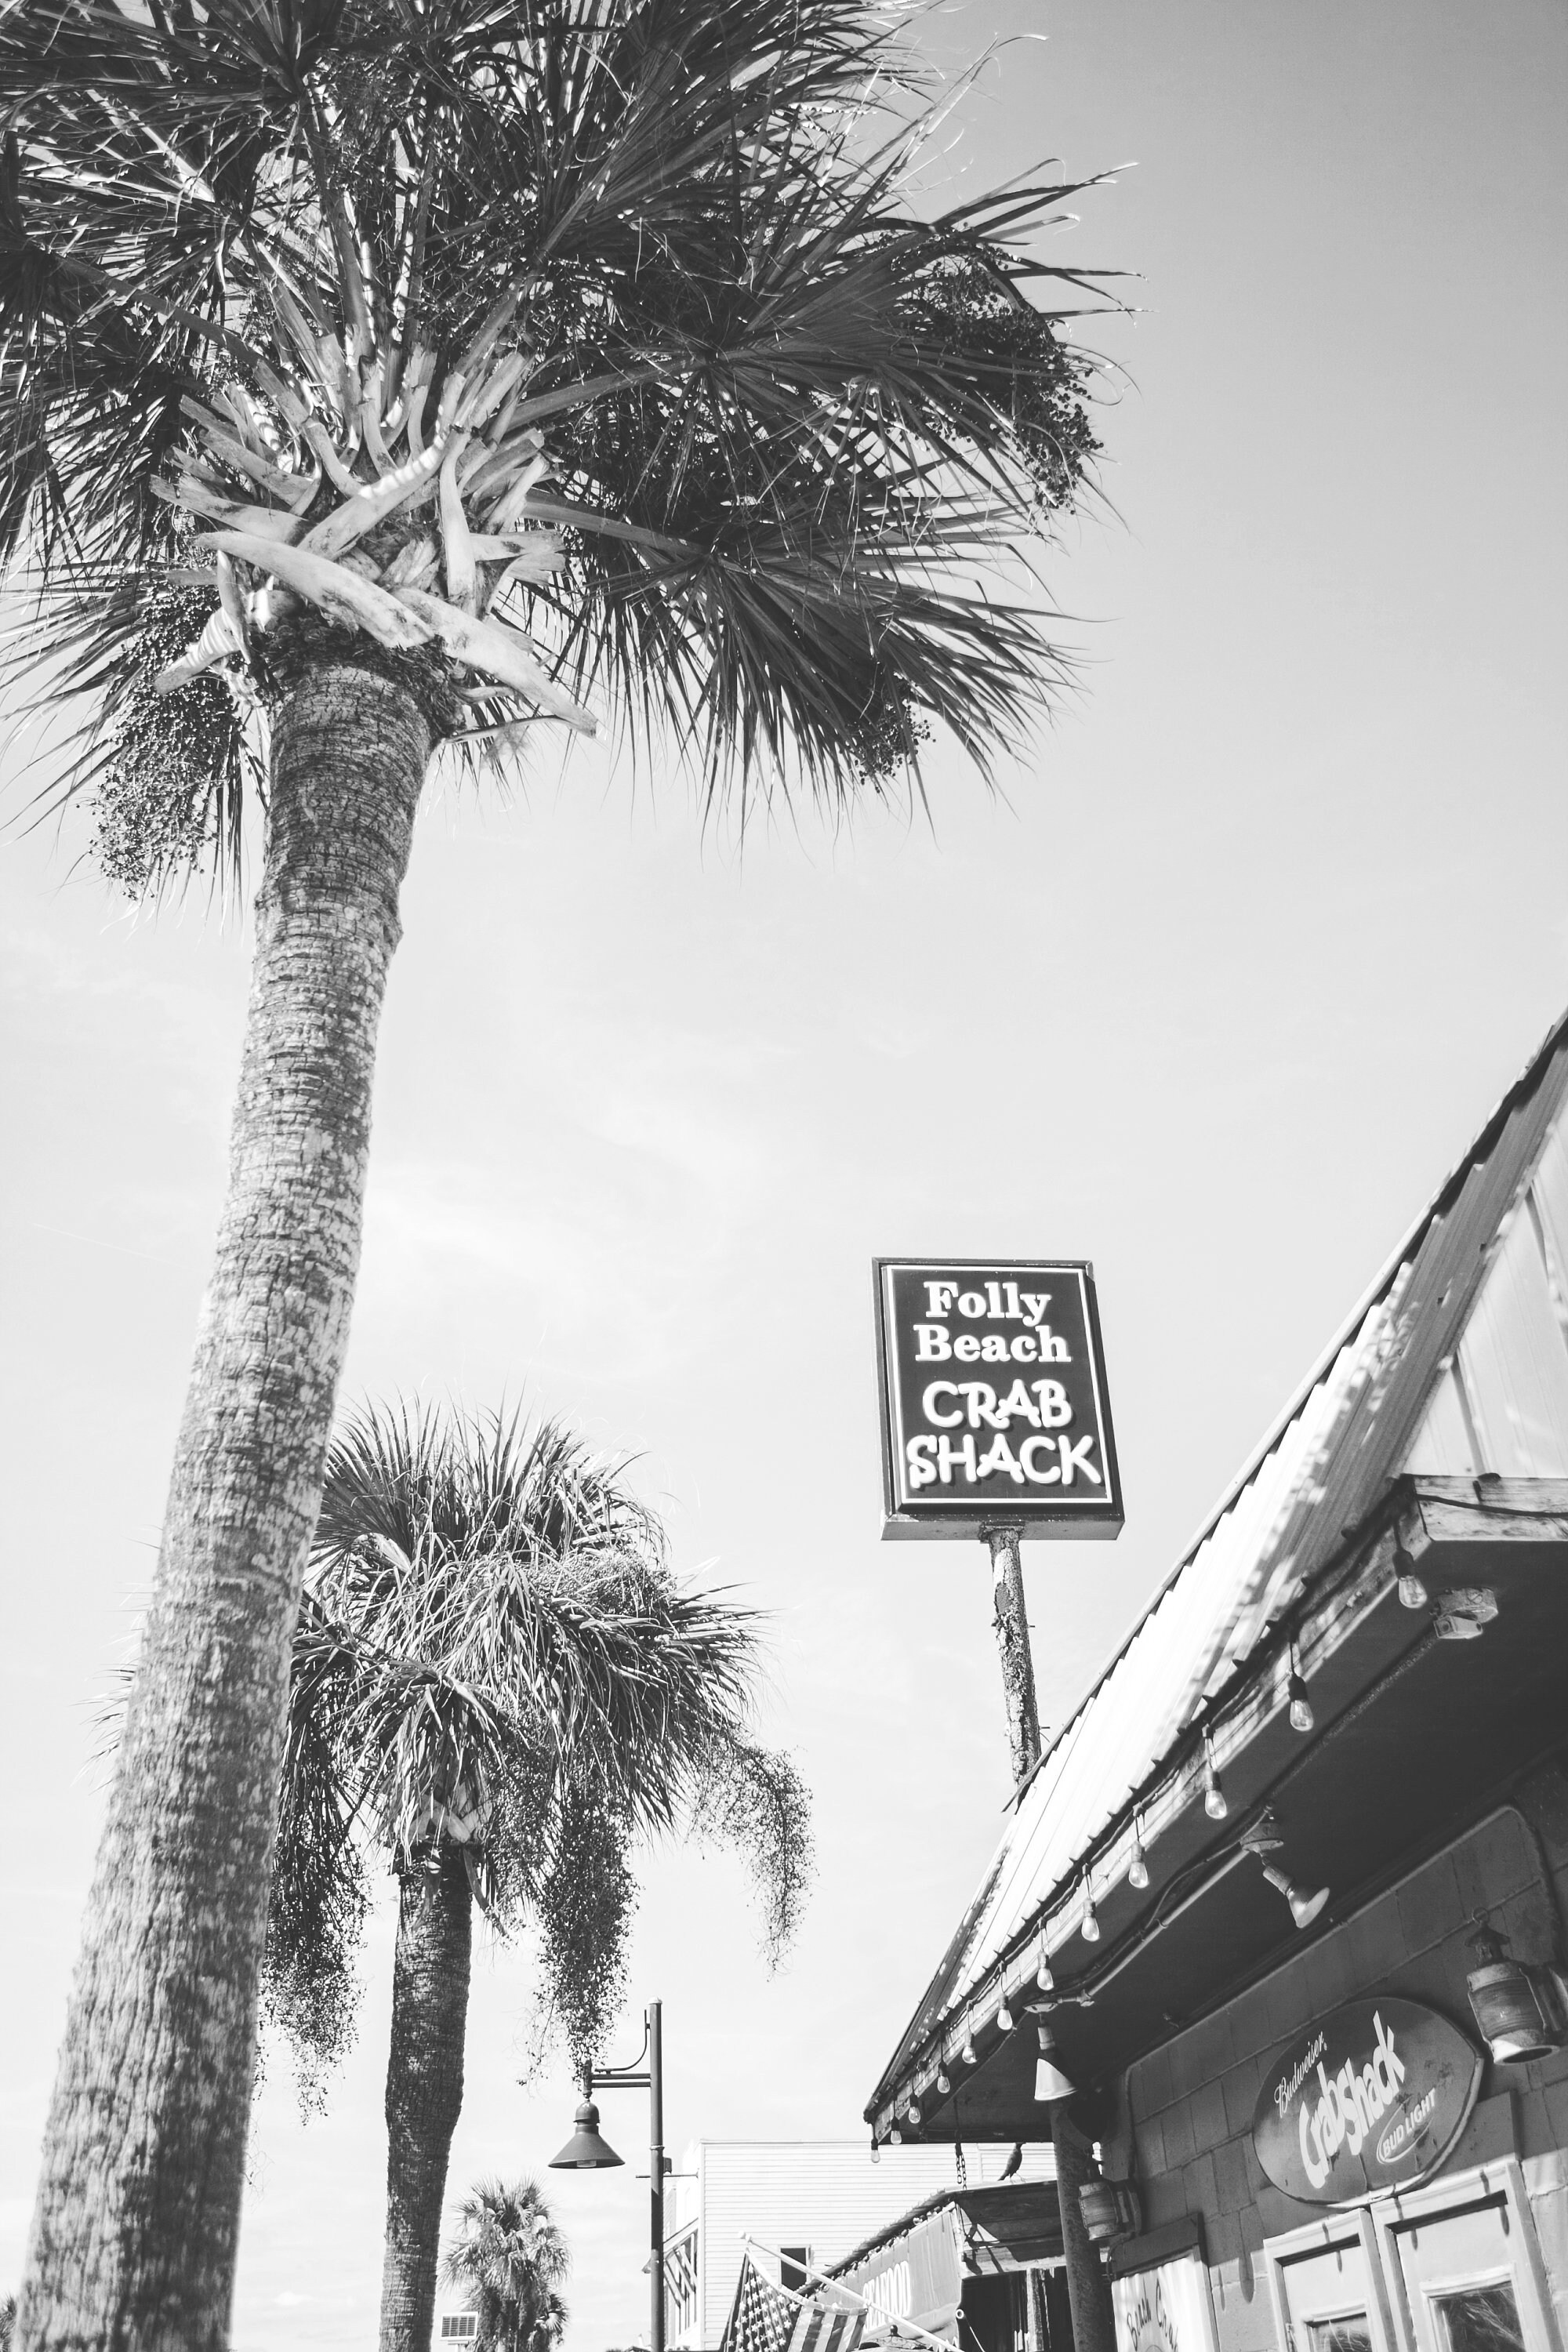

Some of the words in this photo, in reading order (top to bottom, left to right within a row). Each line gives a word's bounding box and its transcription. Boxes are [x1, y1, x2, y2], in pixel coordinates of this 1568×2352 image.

[924, 1281, 1053, 1327] Folly
[913, 1323, 1072, 1362] Beach
[922, 1378, 1074, 1429] CRAB
[906, 1432, 1102, 1489] SHACK
[1274, 2031, 1324, 2119] Budweiser
[1382, 2124, 1405, 2159] BUD
[1405, 2087, 1436, 2136] LIGHT
[862, 2260, 912, 2334] SEAFOOD
[1127, 2277, 1152, 2351] Beach
